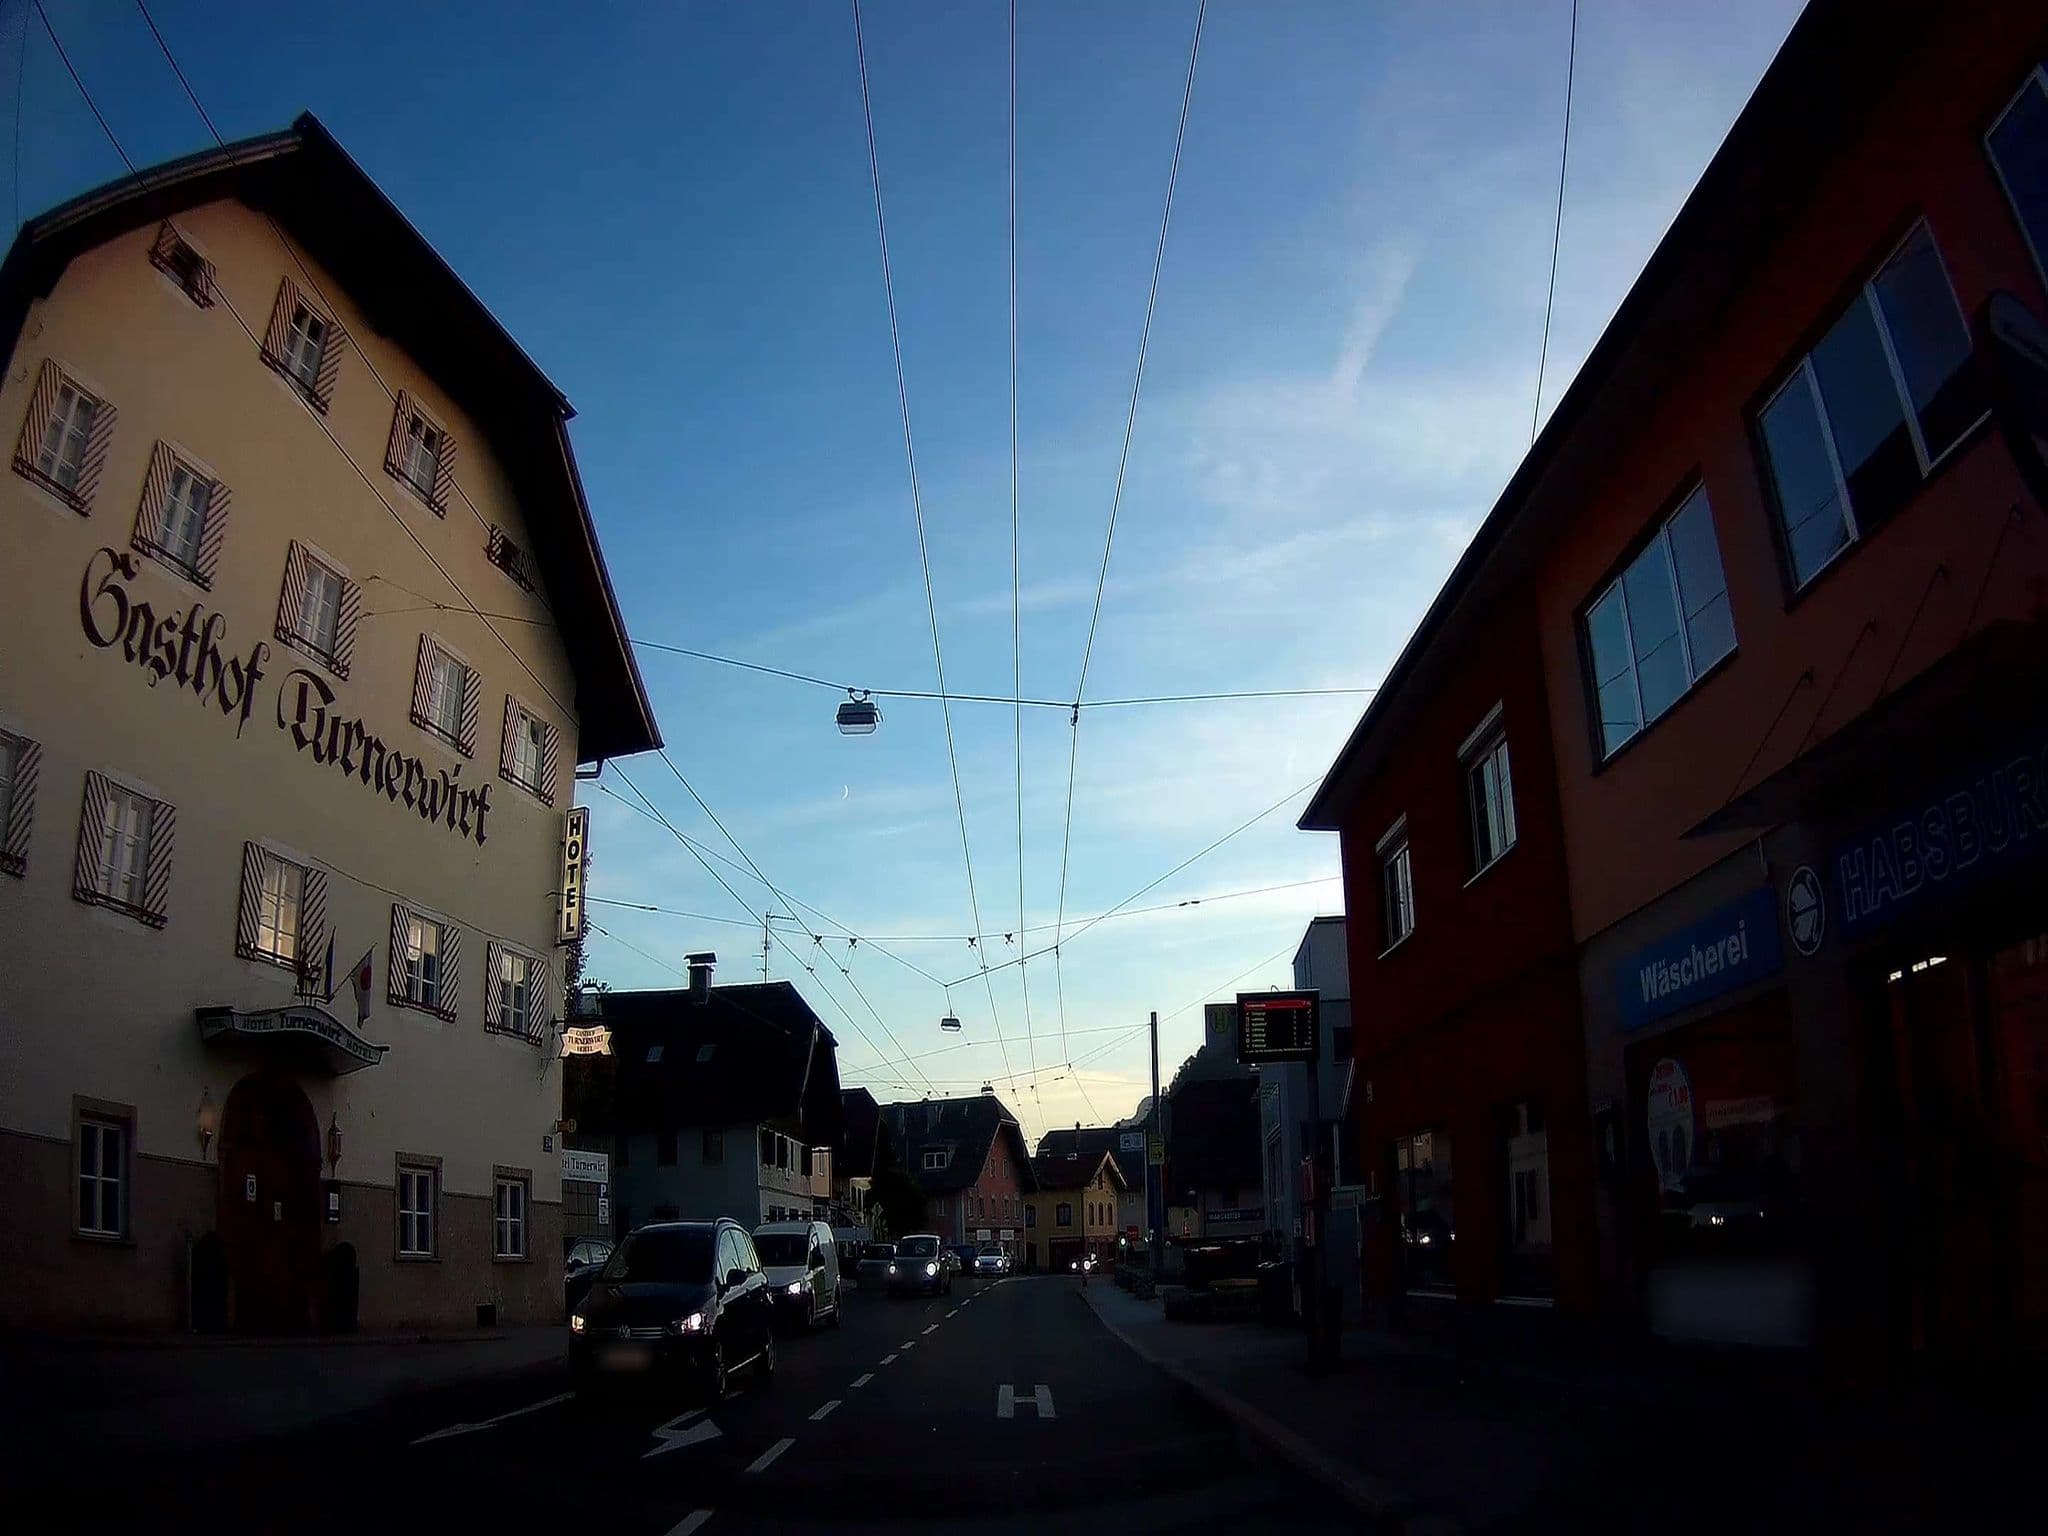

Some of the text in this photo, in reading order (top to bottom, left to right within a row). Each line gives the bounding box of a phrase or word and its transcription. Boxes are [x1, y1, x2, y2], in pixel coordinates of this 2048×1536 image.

[80, 547, 491, 847] Gasthof Turnerwirt
[566, 815, 582, 932] HOTEL
[1840, 743, 2048, 923] HABSBUR
[1640, 920, 1749, 1001] Wäscherei
[600, 1184, 607, 1197] P
[997, 1384, 1056, 1418] H
